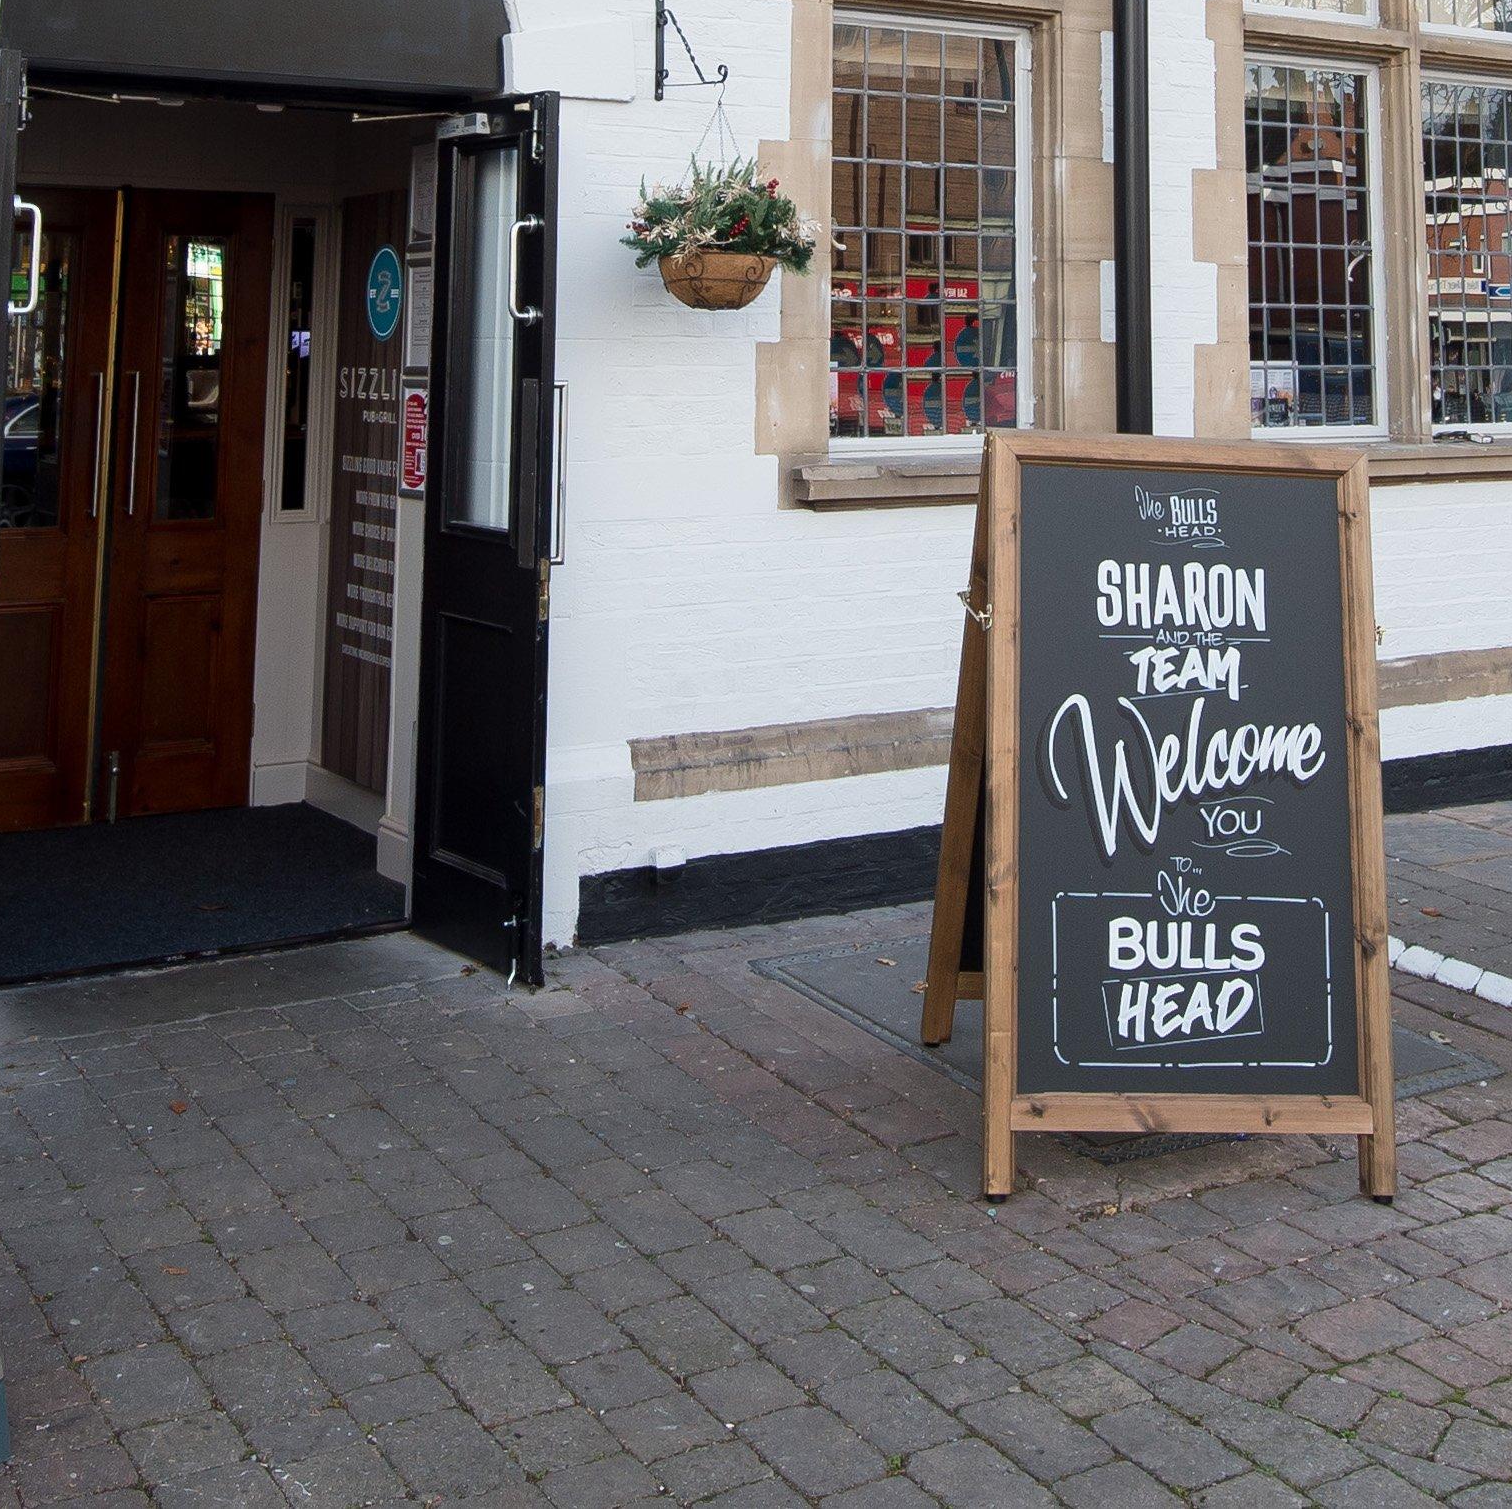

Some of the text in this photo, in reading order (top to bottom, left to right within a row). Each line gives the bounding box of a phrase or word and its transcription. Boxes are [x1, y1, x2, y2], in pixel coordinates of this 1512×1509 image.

[1135, 484, 1218, 526] The BULLS
[1096, 558, 1266, 632] SHARON
[1155, 629, 1225, 647] AND THE
[1128, 646, 1241, 702] TEAM
[1048, 693, 1327, 857] Welcome
[1199, 805, 1263, 838] YOU
[1157, 870, 1216, 917] The
[1107, 916, 1266, 972] BULLS
[1117, 979, 1255, 1043] HEAD
